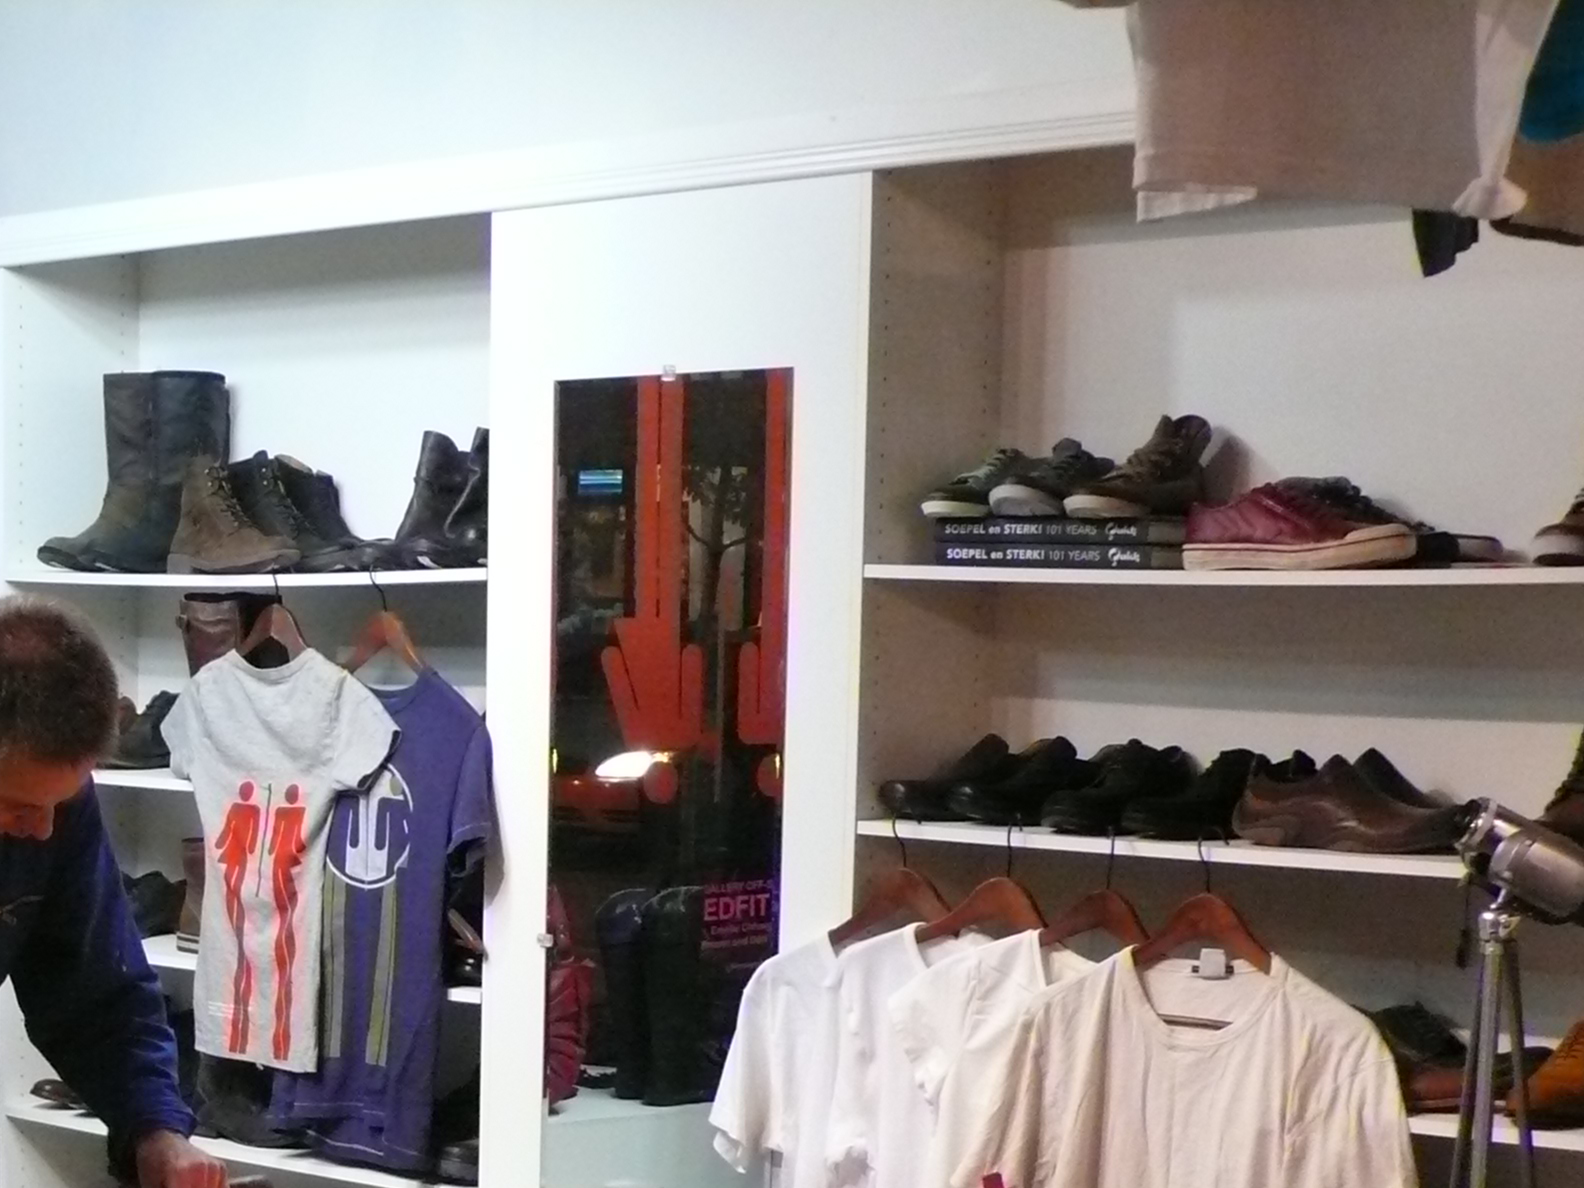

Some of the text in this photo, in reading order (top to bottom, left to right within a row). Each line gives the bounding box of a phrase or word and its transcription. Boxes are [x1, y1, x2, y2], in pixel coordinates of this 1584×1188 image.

[1046, 524, 1062, 535] 101
[1066, 524, 1097, 535] YEARS
[946, 548, 988, 559] SOEPEL
[990, 550, 1004, 559] en
[1048, 550, 1065, 561] 101
[1068, 550, 1101, 561] YEARS
[703, 893, 770, 921] EDFIT
